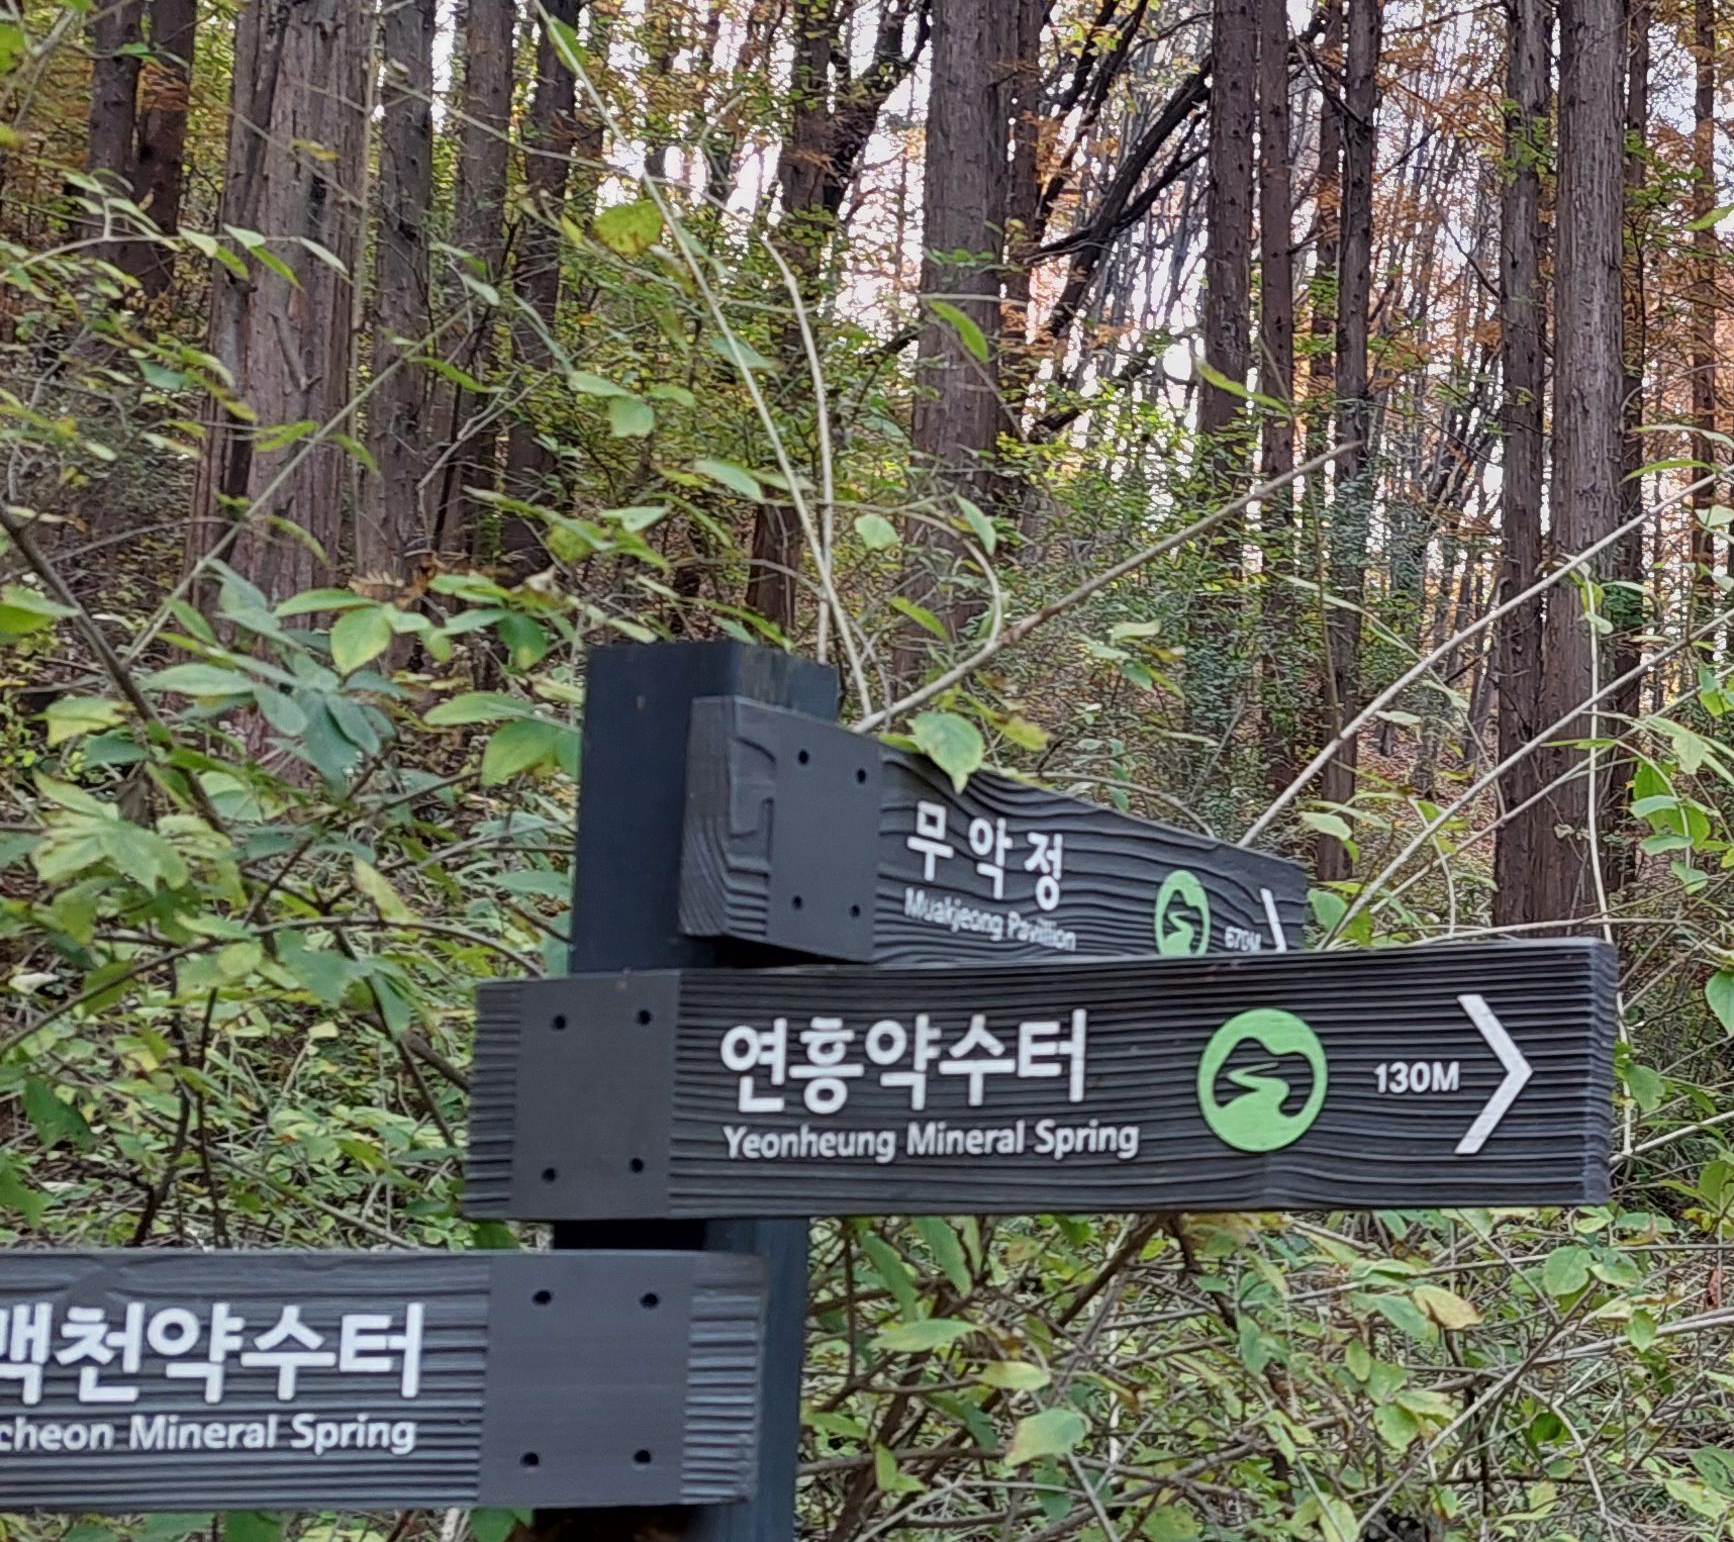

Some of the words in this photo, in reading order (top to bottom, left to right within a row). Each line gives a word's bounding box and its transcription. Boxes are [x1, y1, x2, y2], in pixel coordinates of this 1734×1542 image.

[906, 800, 1063, 911] 무악정
[719, 1008, 1088, 1115] 연흥약수터
[1374, 1061, 1460, 1094] 130M
[722, 1124, 896, 1163] Yeonheung
[907, 1119, 1024, 1156] Mineral
[1034, 1119, 1140, 1160] Spring
[129, 1414, 278, 1451] Mineral
[290, 1412, 418, 1456] Spring
